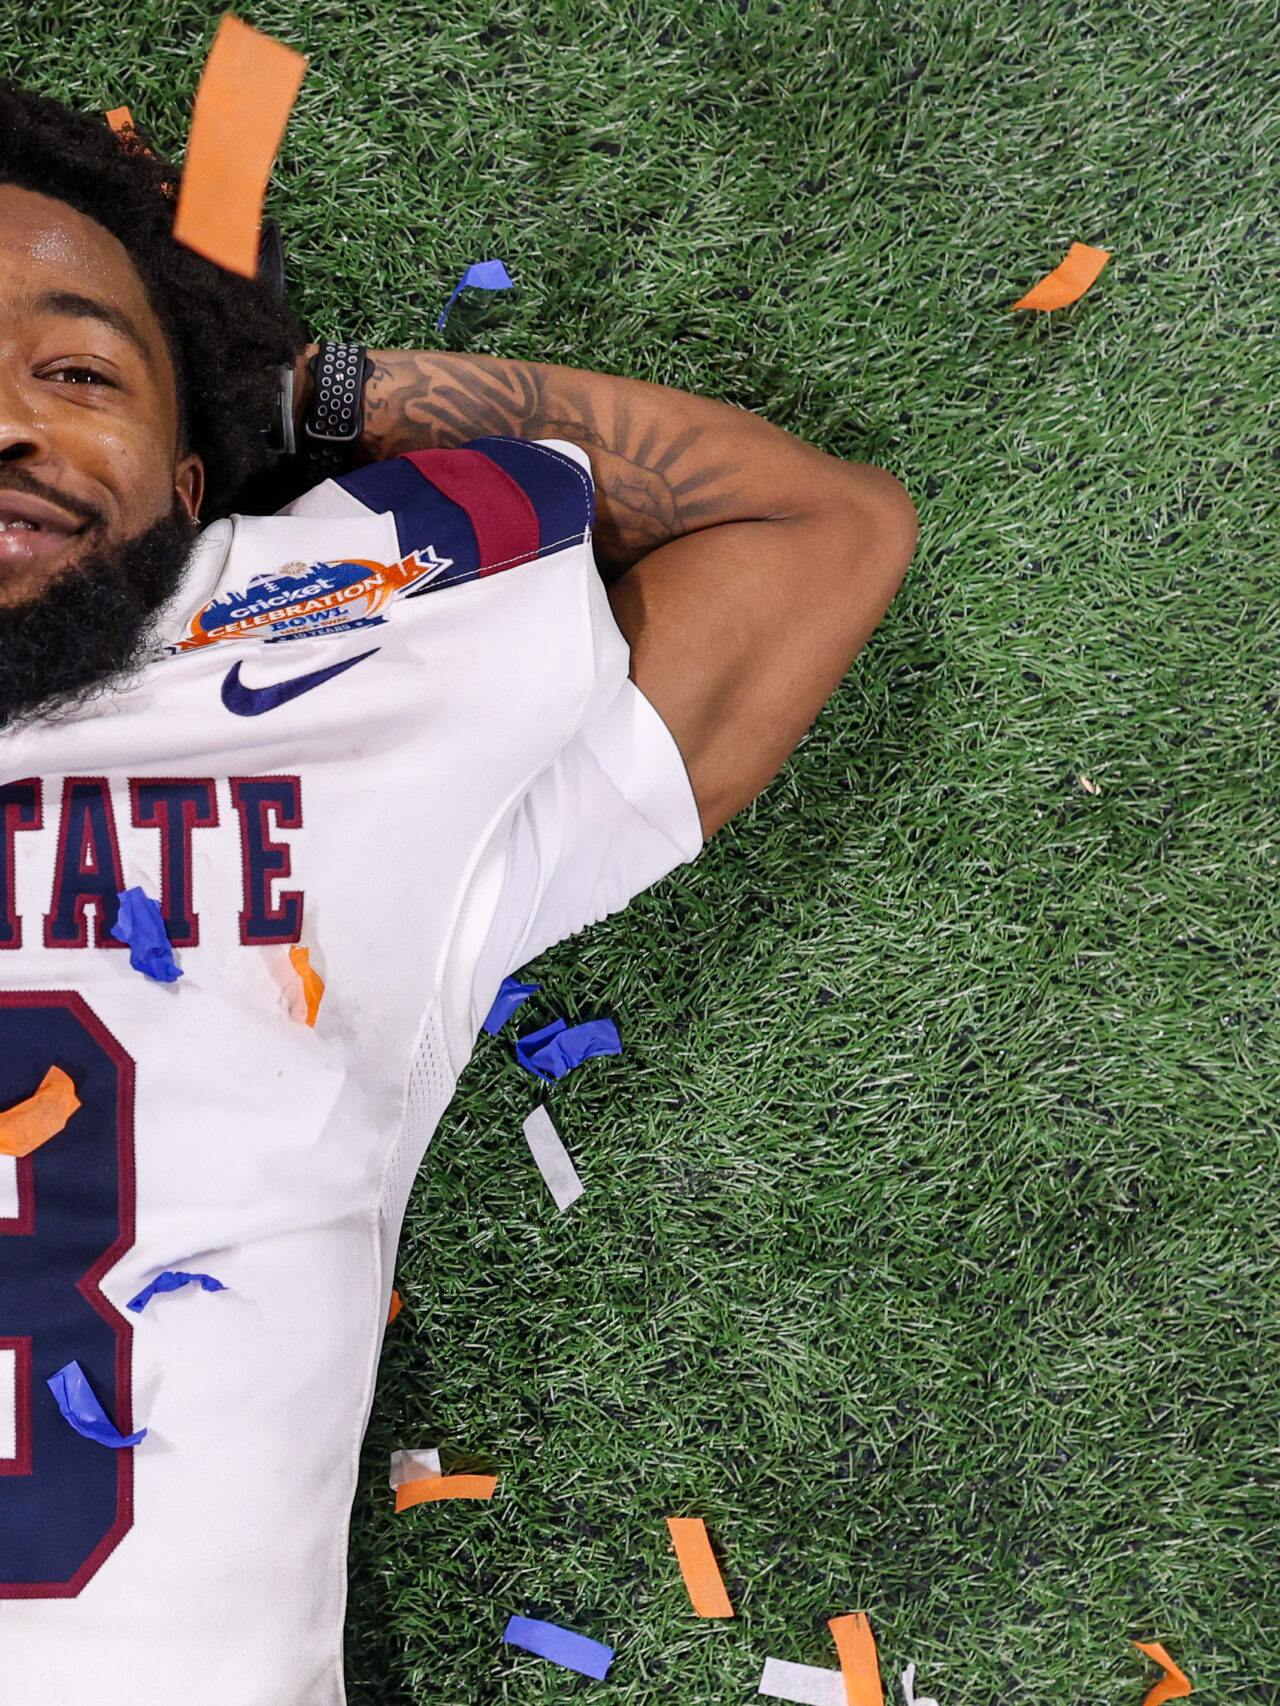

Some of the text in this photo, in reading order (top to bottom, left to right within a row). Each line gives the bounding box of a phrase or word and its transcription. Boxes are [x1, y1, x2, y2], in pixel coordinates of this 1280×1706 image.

[207, 572, 385, 638] CELEBRATION
[230, 577, 336, 618] cricket
[270, 607, 350, 631] BOWL
[280, 616, 351, 635] MEAC SWAC
[309, 624, 351, 637] YEARS
